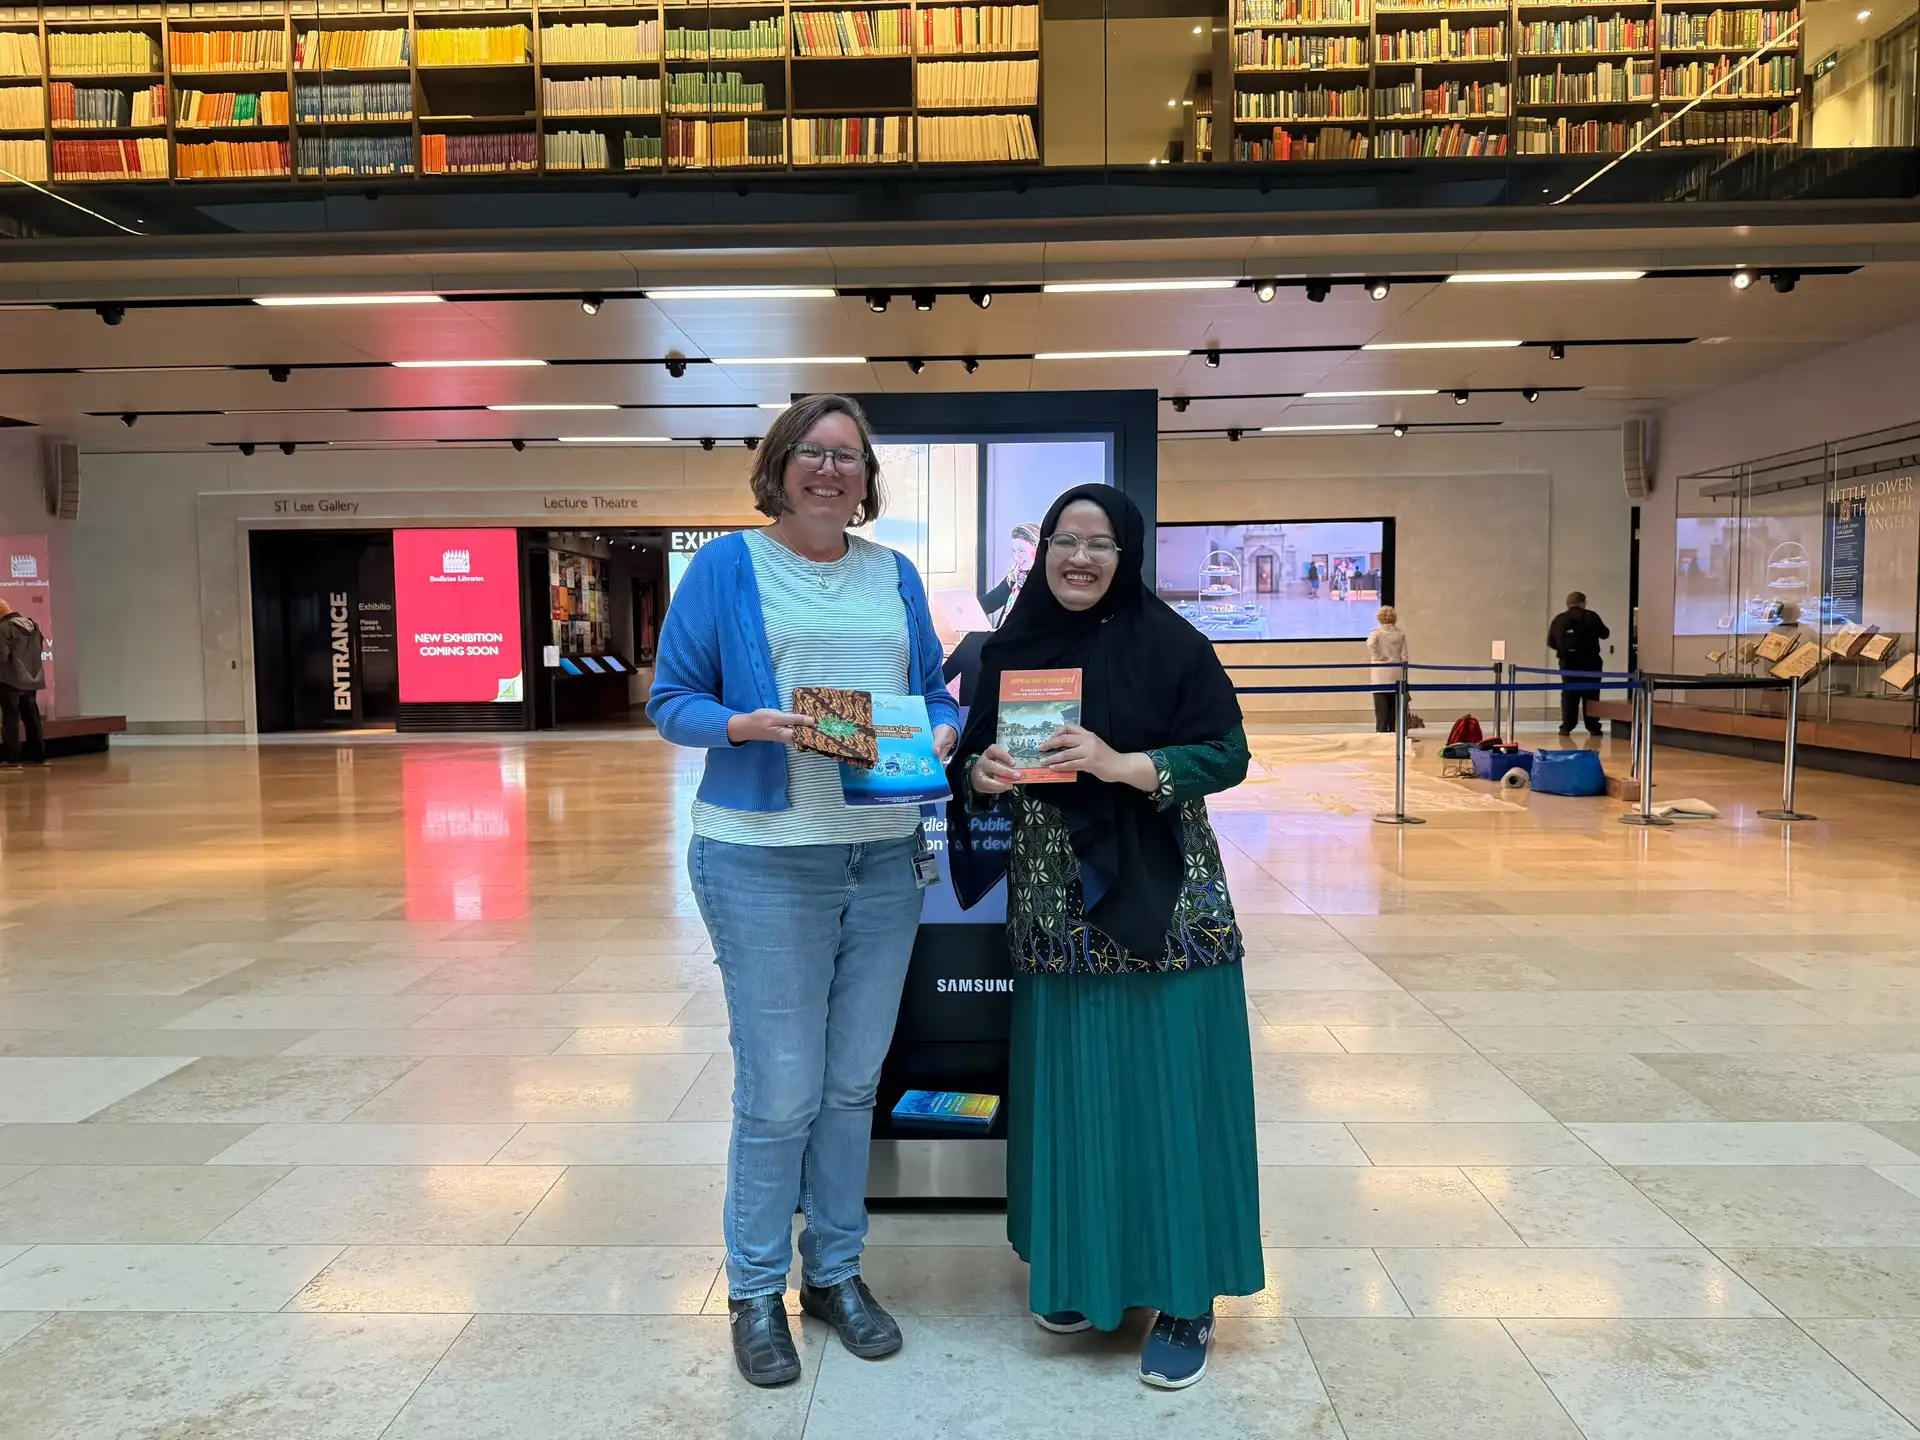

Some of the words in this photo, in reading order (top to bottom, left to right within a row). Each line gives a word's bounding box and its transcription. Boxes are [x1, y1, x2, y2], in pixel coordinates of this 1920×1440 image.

[1830, 485, 1866, 503] LITTLE
[1871, 476, 1913, 497] LOWER
[274, 501, 288, 512] ST
[294, 501, 314, 512] Lee
[319, 500, 359, 514] Gallery
[544, 497, 588, 508] Lecture
[592, 496, 638, 508] Theatre
[1852, 499, 1885, 517] THAN
[358, 602, 392, 611] Exhibitio
[414, 633, 440, 643] NEW
[443, 632, 503, 643] EXHIBITION
[330, 592, 352, 711] ENTRANCE
[420, 647, 464, 656] COMING
[466, 646, 499, 656] SOON
[982, 835, 1013, 850] devi
